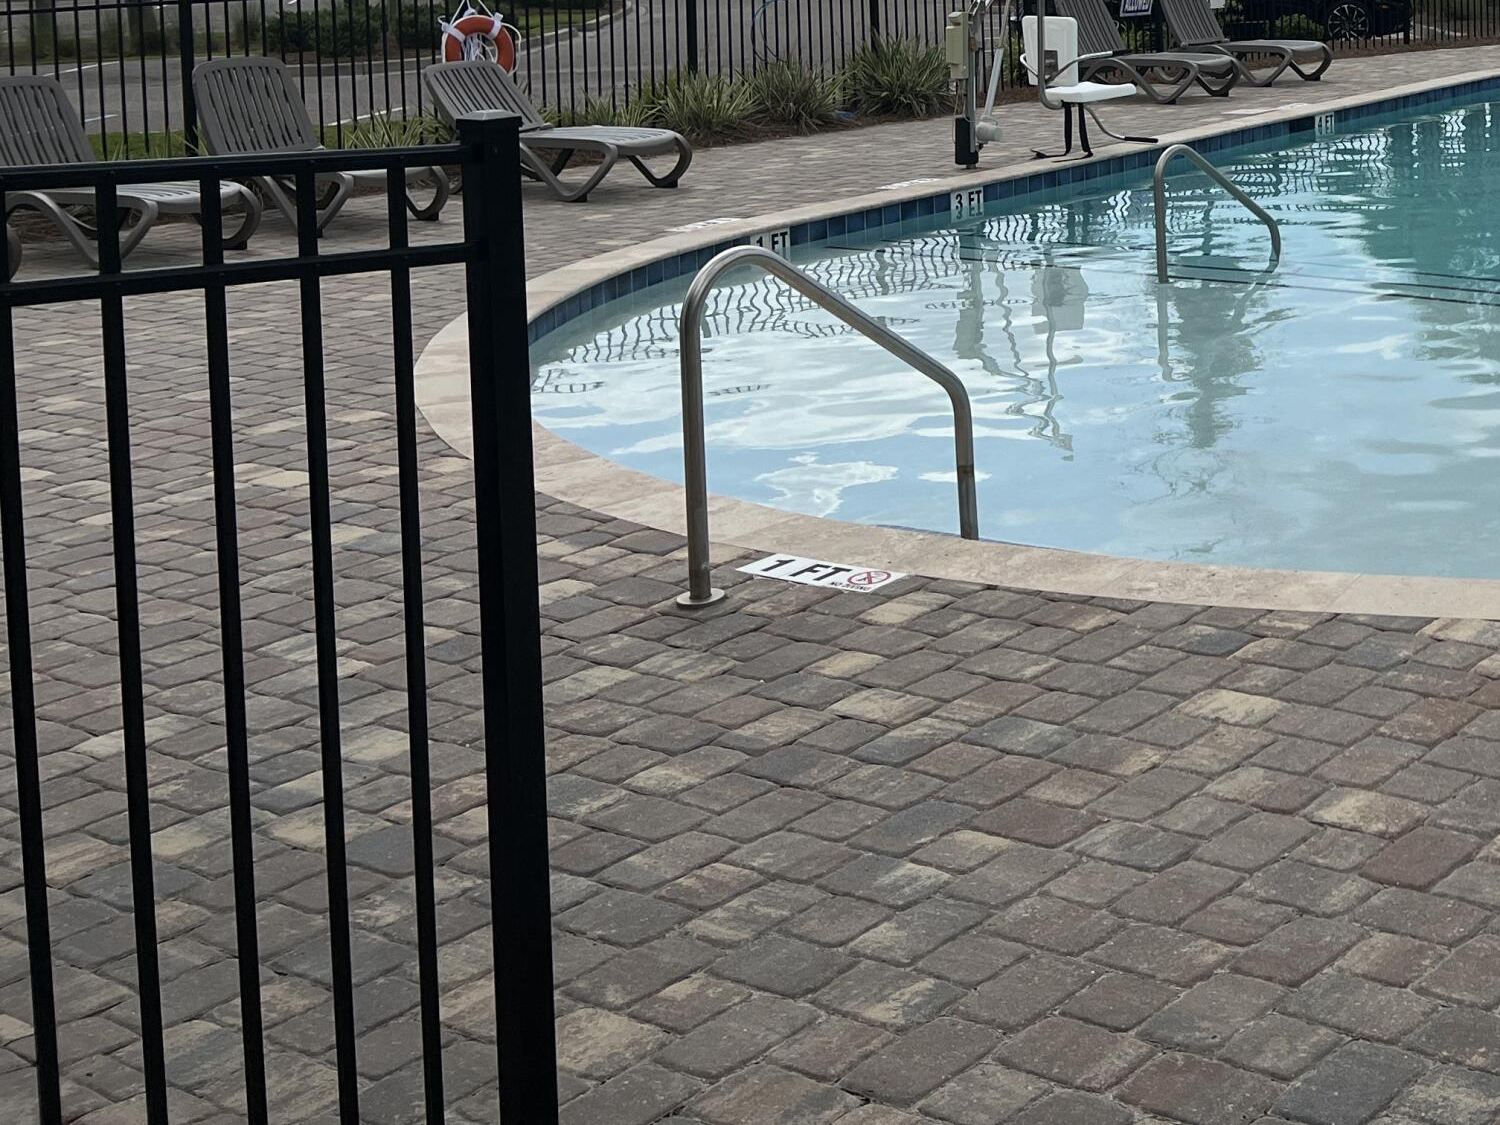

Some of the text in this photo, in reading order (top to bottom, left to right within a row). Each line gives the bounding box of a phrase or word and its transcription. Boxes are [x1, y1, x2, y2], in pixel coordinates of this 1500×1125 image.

[955, 190, 982, 208] 3 FT
[756, 231, 788, 251] 1 FT
[760, 559, 853, 582] 1 FT
